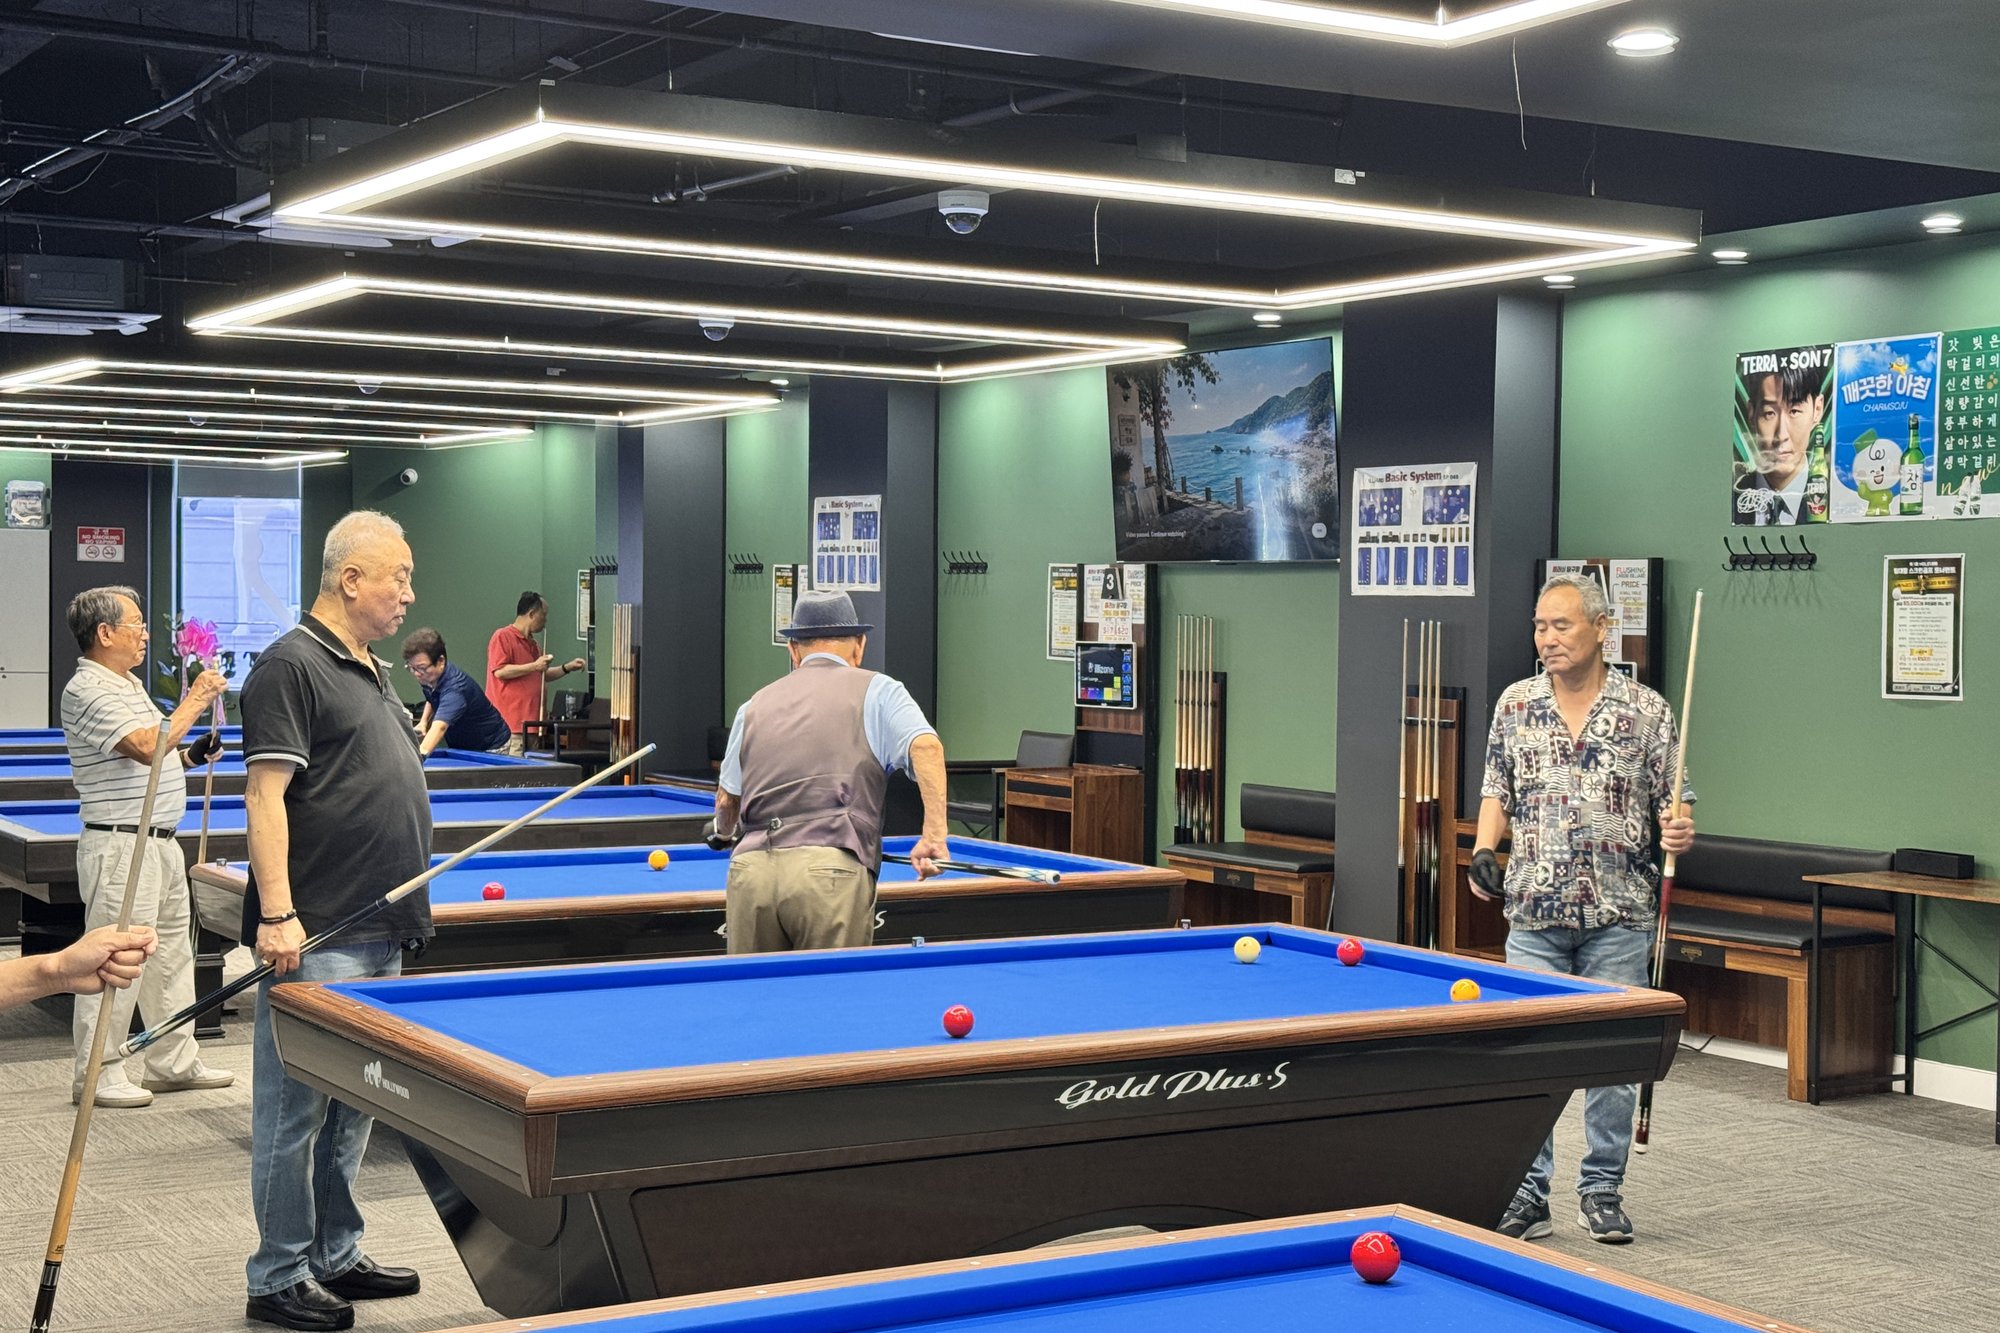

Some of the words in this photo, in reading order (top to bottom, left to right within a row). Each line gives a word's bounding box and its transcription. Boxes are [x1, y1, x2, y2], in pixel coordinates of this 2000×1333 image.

[1948, 337, 1959, 352] 갓
[1741, 353, 1778, 375] TERRA
[1946, 353, 1999, 372] 막걸리의
[1841, 373, 1893, 404] 깨끗한
[1895, 374, 1932, 401] 아침
[1945, 374, 1985, 392] 신선한
[1862, 401, 1908, 413] CHARMSOJU
[1944, 393, 1998, 411] 청량감이
[1943, 413, 1997, 431] 풍부하게
[1944, 434, 1997, 451] 살아있는
[1943, 453, 1997, 470] 생막걸리
[1385, 472, 1408, 482] Basic
[1410, 471, 1442, 483] System
[1906, 469, 1919, 490] 참
[1106, 573, 1115, 590] 3
[1054, 1074, 1161, 1110] Gold
